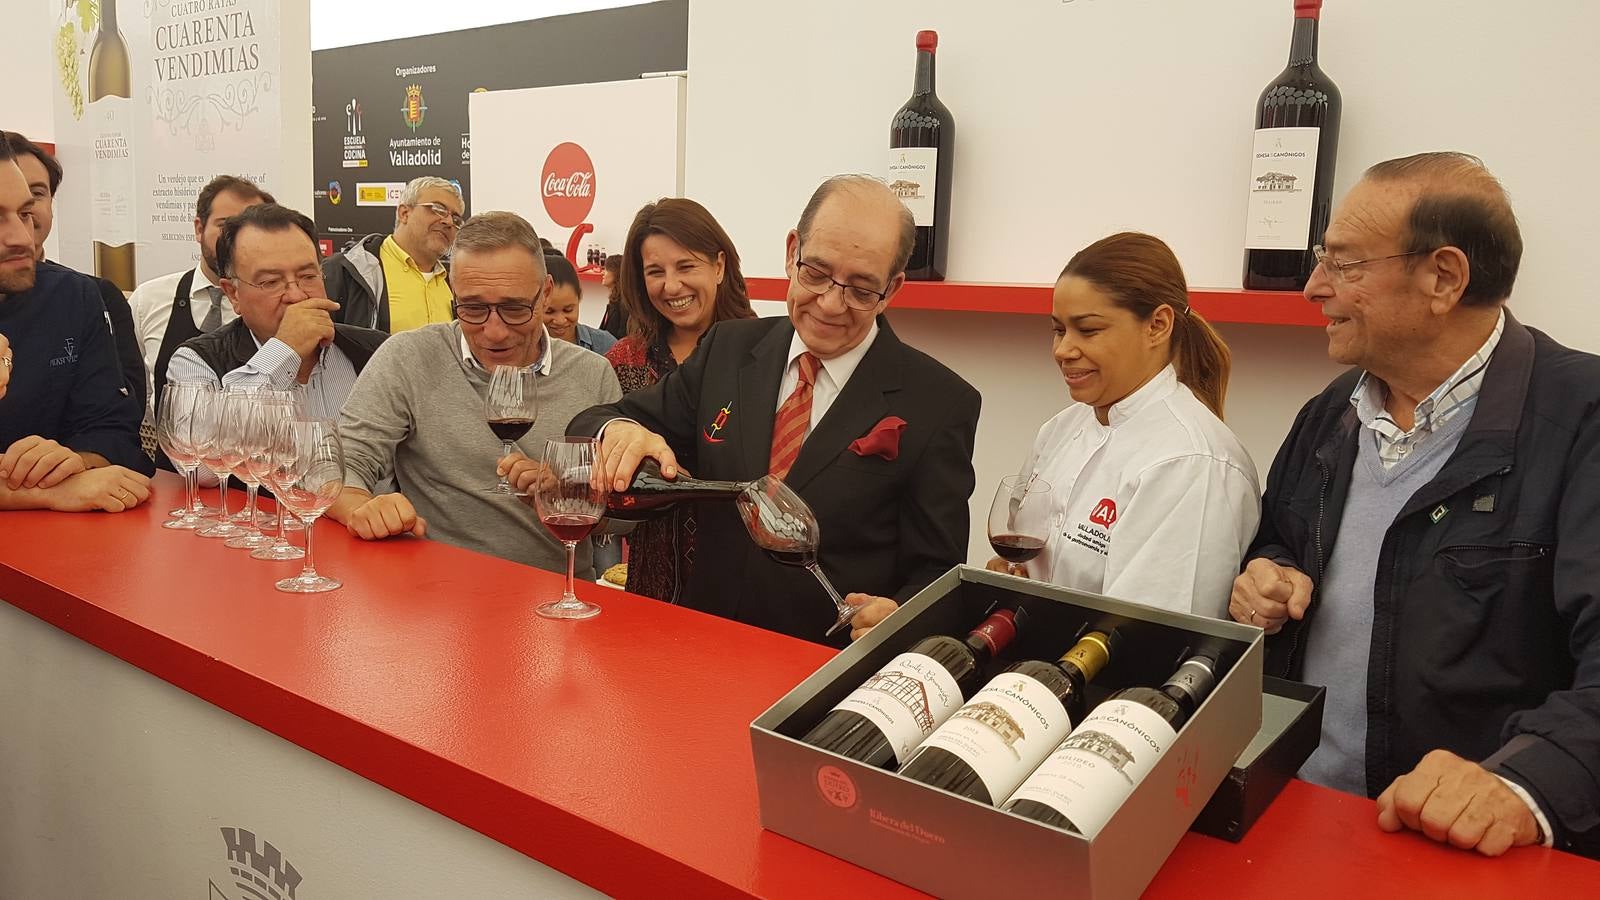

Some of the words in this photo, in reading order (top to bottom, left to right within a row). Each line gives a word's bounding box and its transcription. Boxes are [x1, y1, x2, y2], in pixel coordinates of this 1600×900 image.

[171, 0, 206, 17] CUATRO
[155, 9, 256, 52] CUARENTA
[153, 43, 260, 83] VENDIMIAS
[395, 64, 437, 78] Organizadores
[343, 135, 367, 146] ESCUELA
[389, 136, 432, 150] Ayuntamiento
[432, 135, 442, 147] de
[343, 149, 367, 160] COCINA
[389, 148, 442, 167] Valladolid
[543, 171, 593, 198] Coca-Cola
[1004, 689, 1050, 731] CANÓNIGOS
[1105, 715, 1161, 754] CANÓNIGOS
